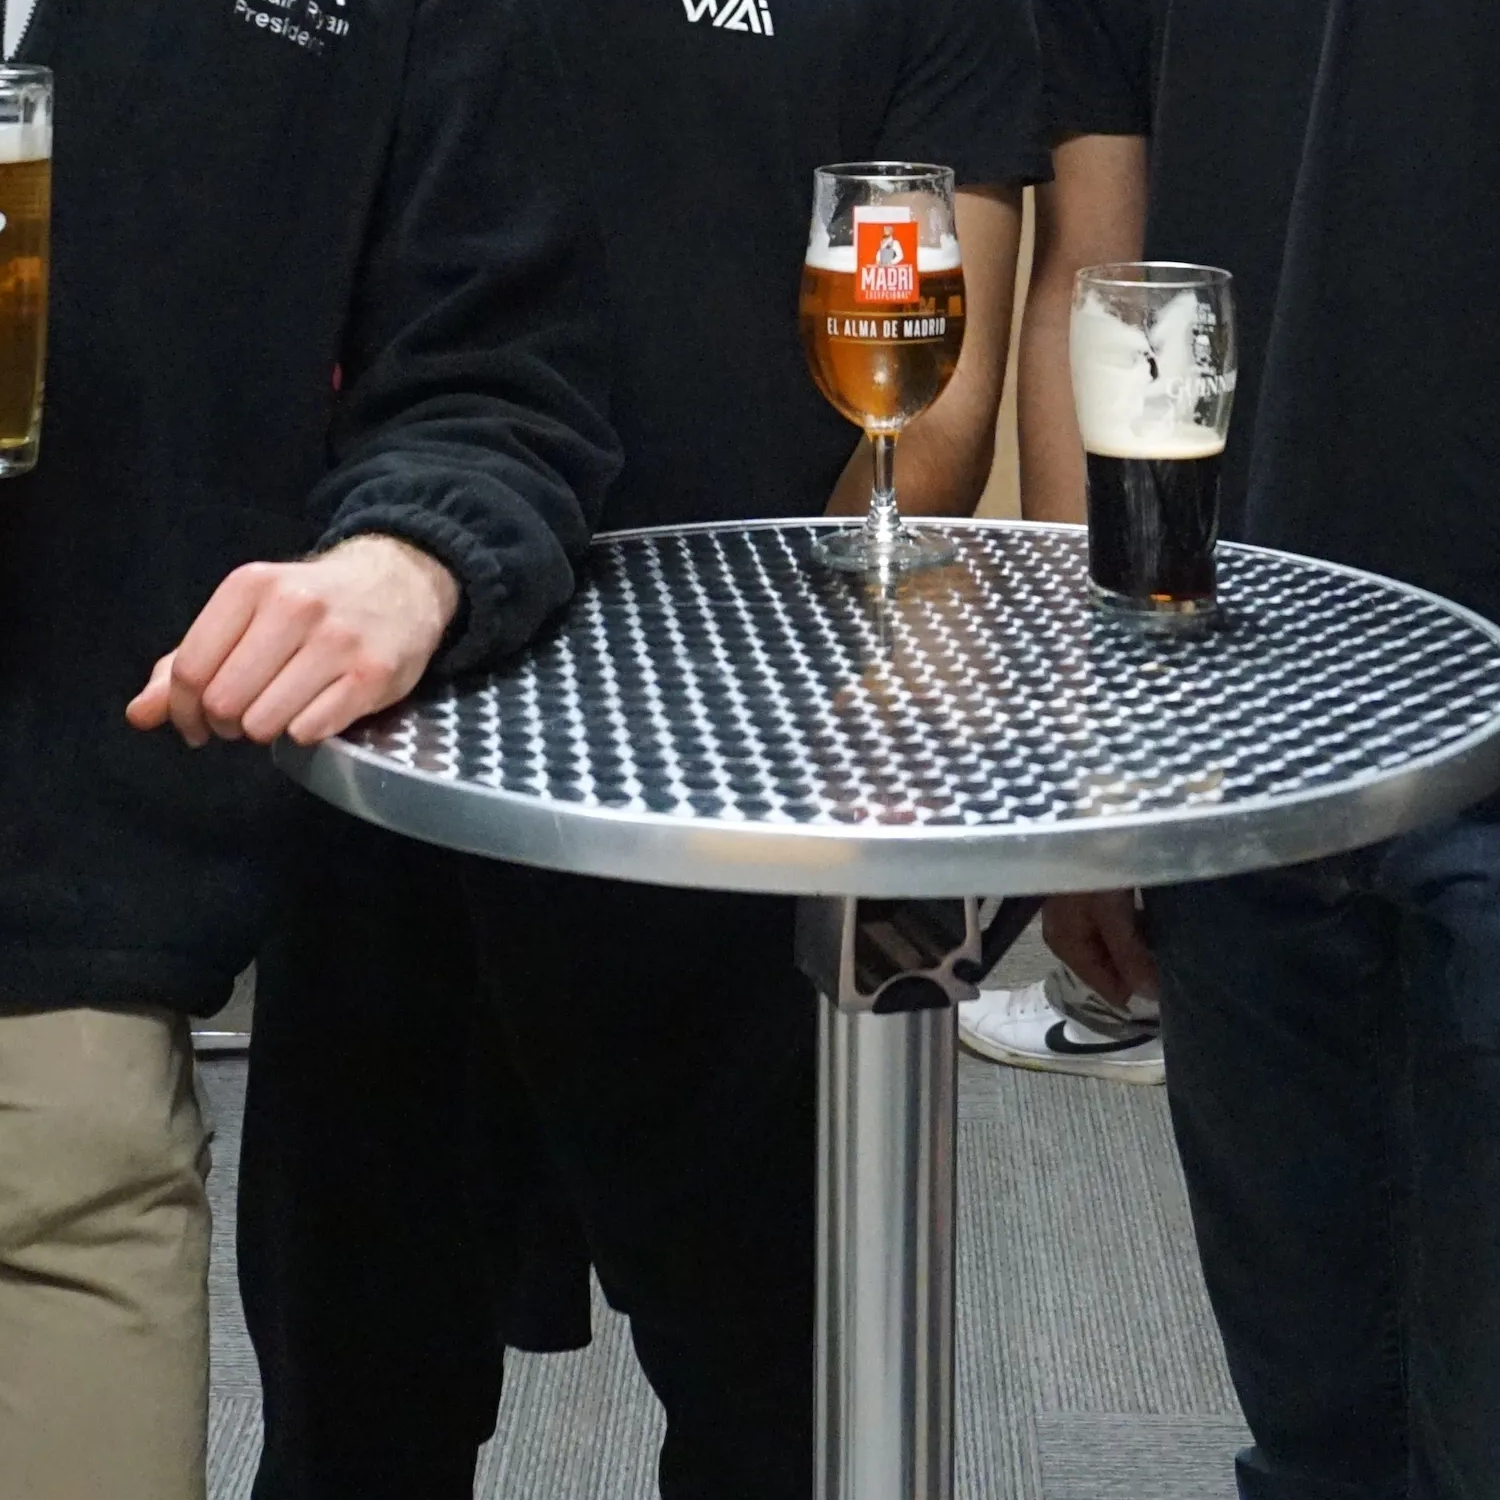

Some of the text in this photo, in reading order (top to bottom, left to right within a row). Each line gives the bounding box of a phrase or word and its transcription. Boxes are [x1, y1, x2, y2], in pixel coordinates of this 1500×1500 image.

[826, 316, 946, 338] EL ALMA DE MADRID
